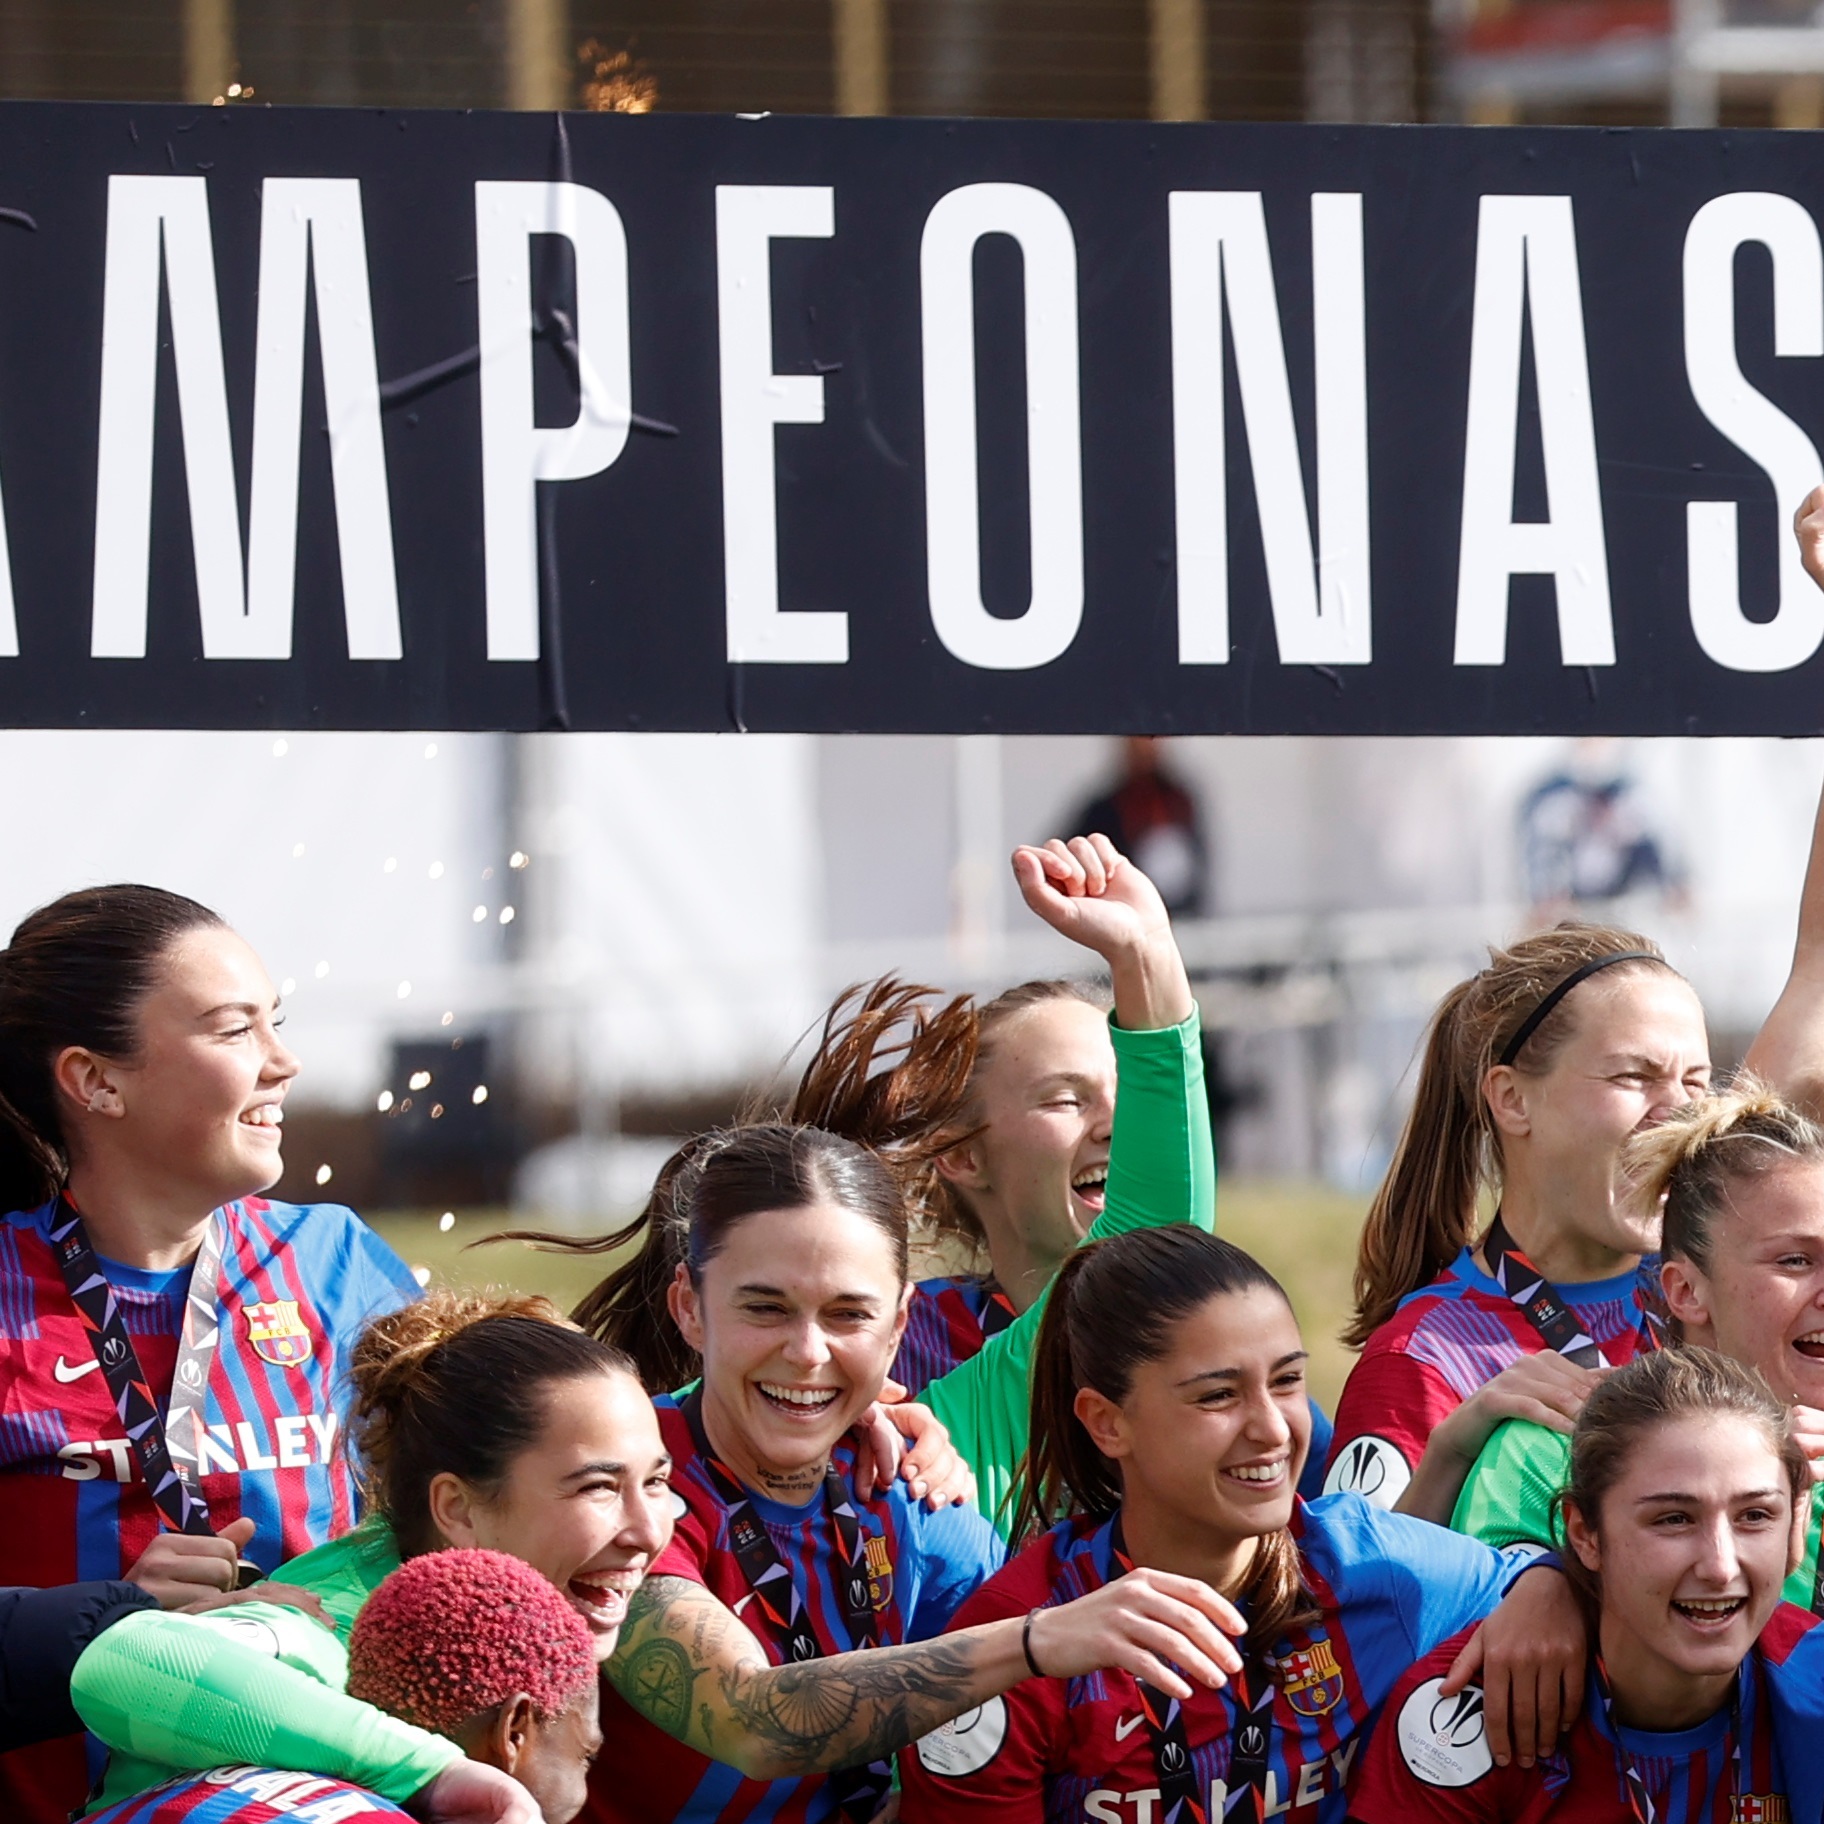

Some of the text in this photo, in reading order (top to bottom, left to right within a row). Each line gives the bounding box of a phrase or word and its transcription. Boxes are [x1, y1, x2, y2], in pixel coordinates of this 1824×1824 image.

[57, 1412, 337, 1483] STNLEY
[1302, 1672, 1325, 1686] FCB
[926, 1734, 971, 1760] PERCOPA
[1408, 1732, 1464, 1774] SUPERCOPA
